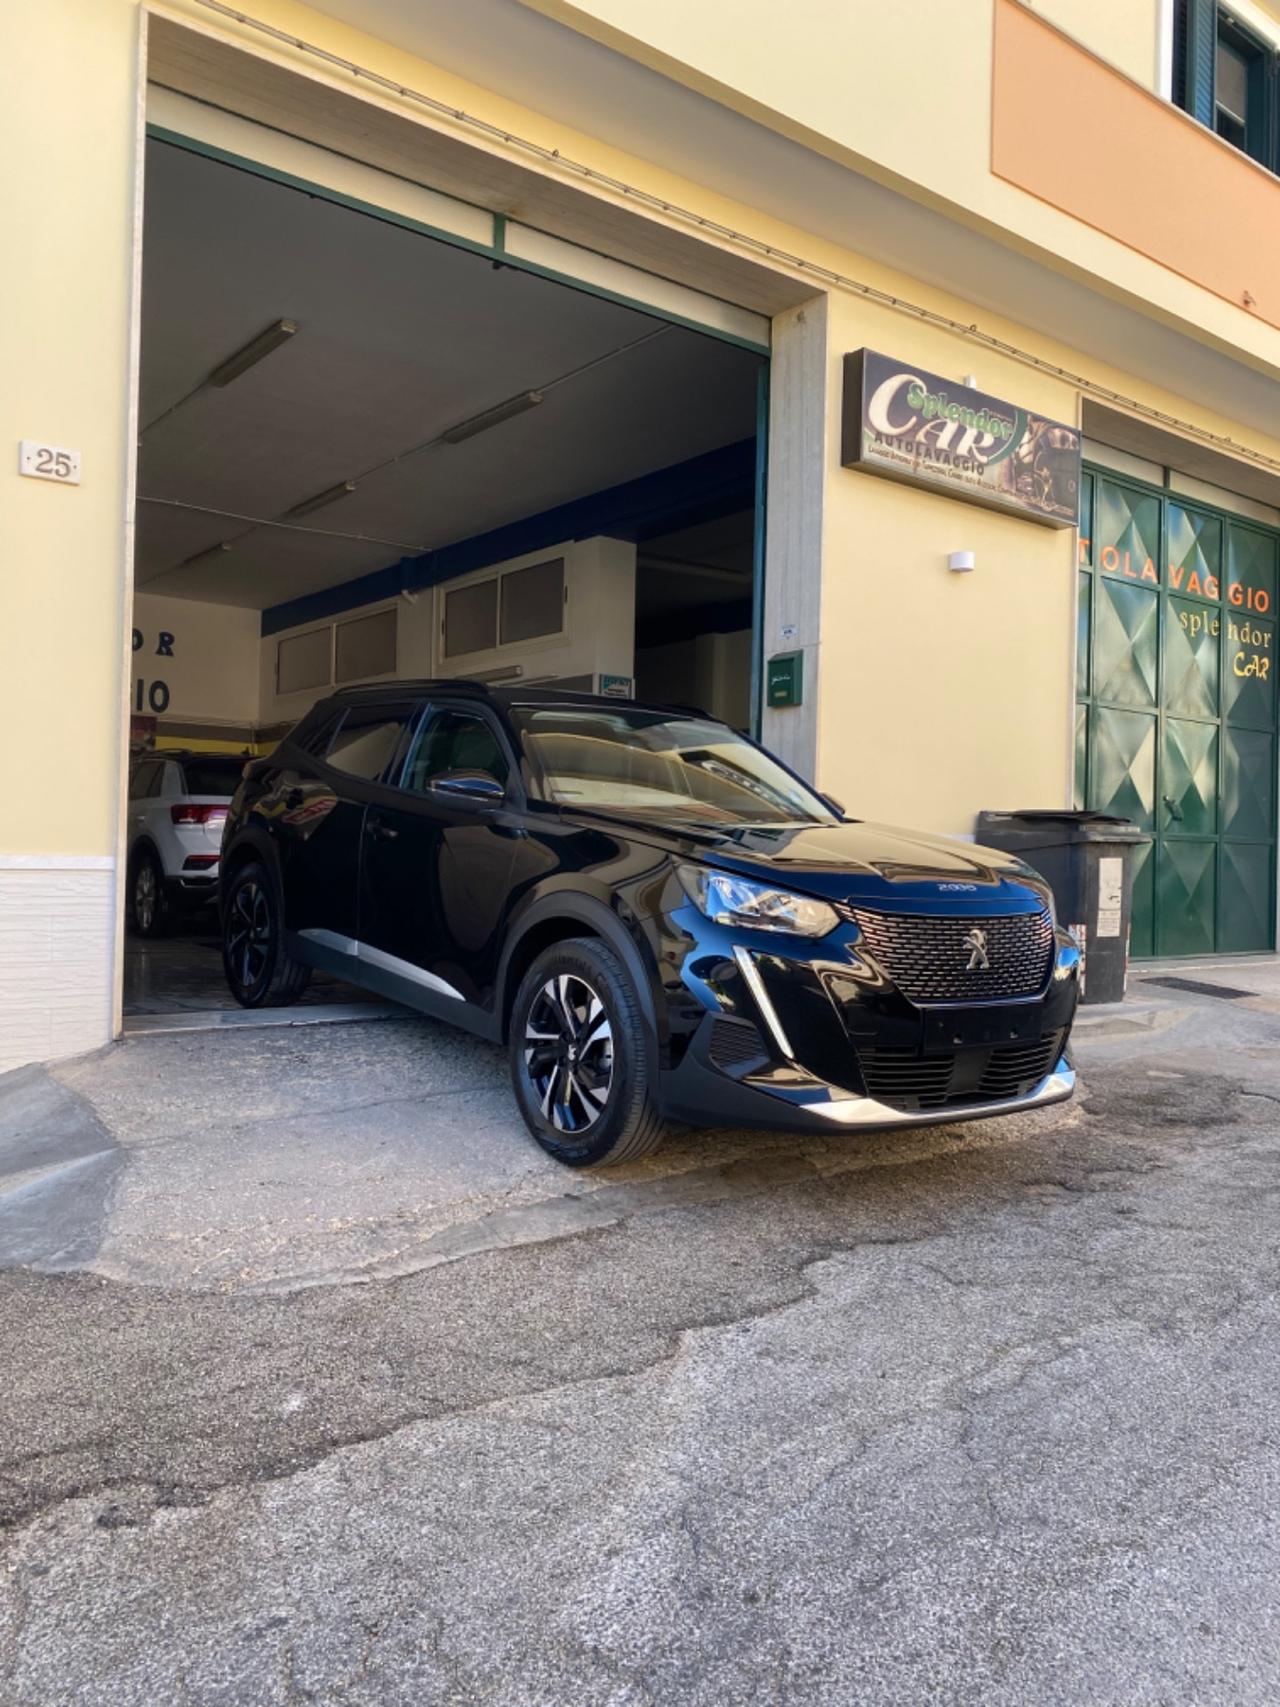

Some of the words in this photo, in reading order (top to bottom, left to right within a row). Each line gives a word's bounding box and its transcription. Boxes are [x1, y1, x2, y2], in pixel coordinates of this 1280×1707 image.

[907, 383, 1013, 441] Splendor
[35, 448, 72, 478] 25
[874, 430, 985, 476] AUTOLAVAGGIO
